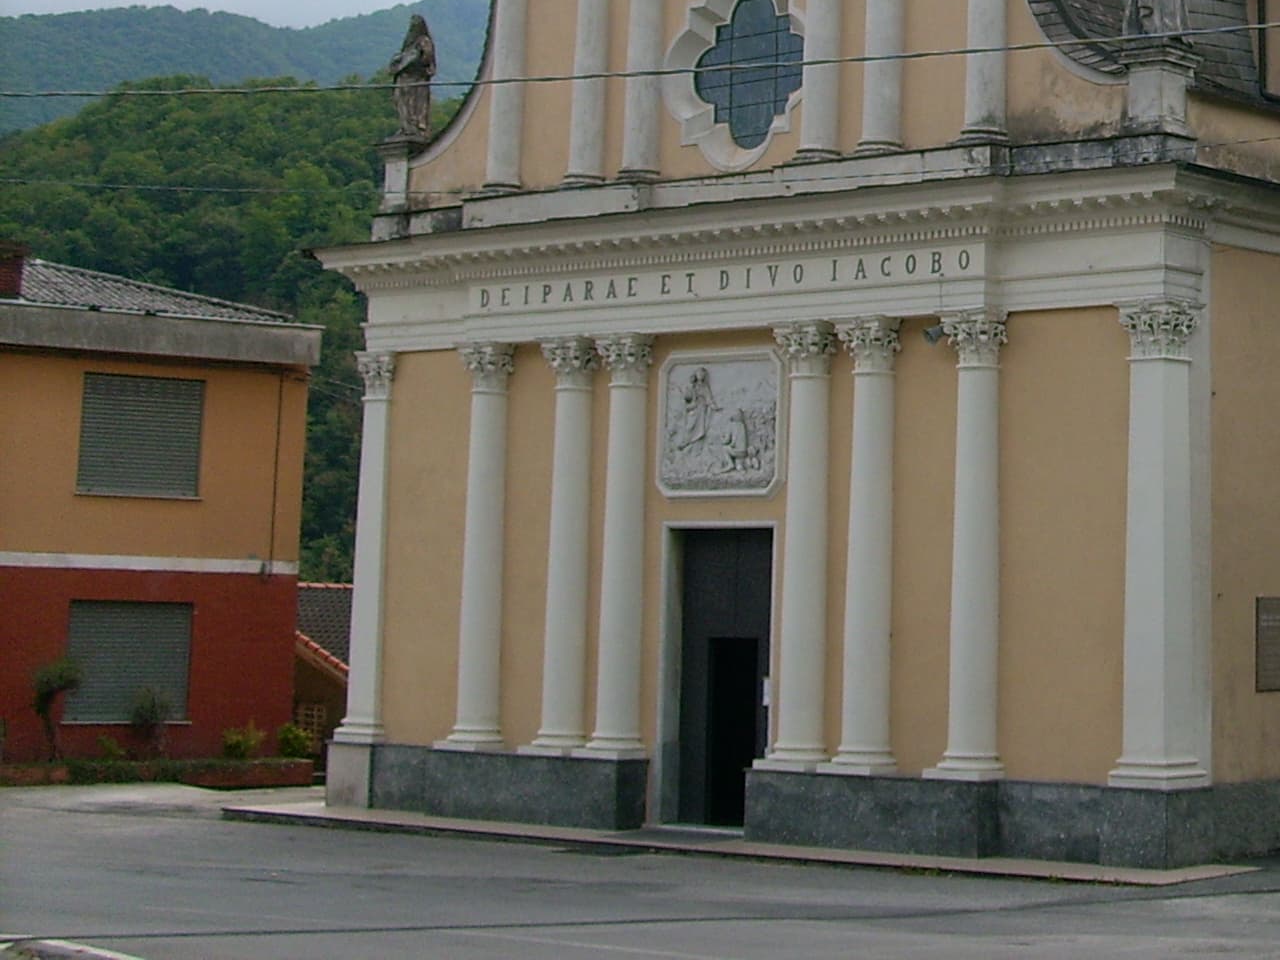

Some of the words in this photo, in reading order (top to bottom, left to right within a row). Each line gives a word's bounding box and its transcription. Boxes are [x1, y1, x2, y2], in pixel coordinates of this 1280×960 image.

[480, 277, 638, 308] DEIPARAE
[660, 272, 696, 295] ET
[719, 263, 804, 290] DIVO
[830, 249, 970, 282] IACOBO
